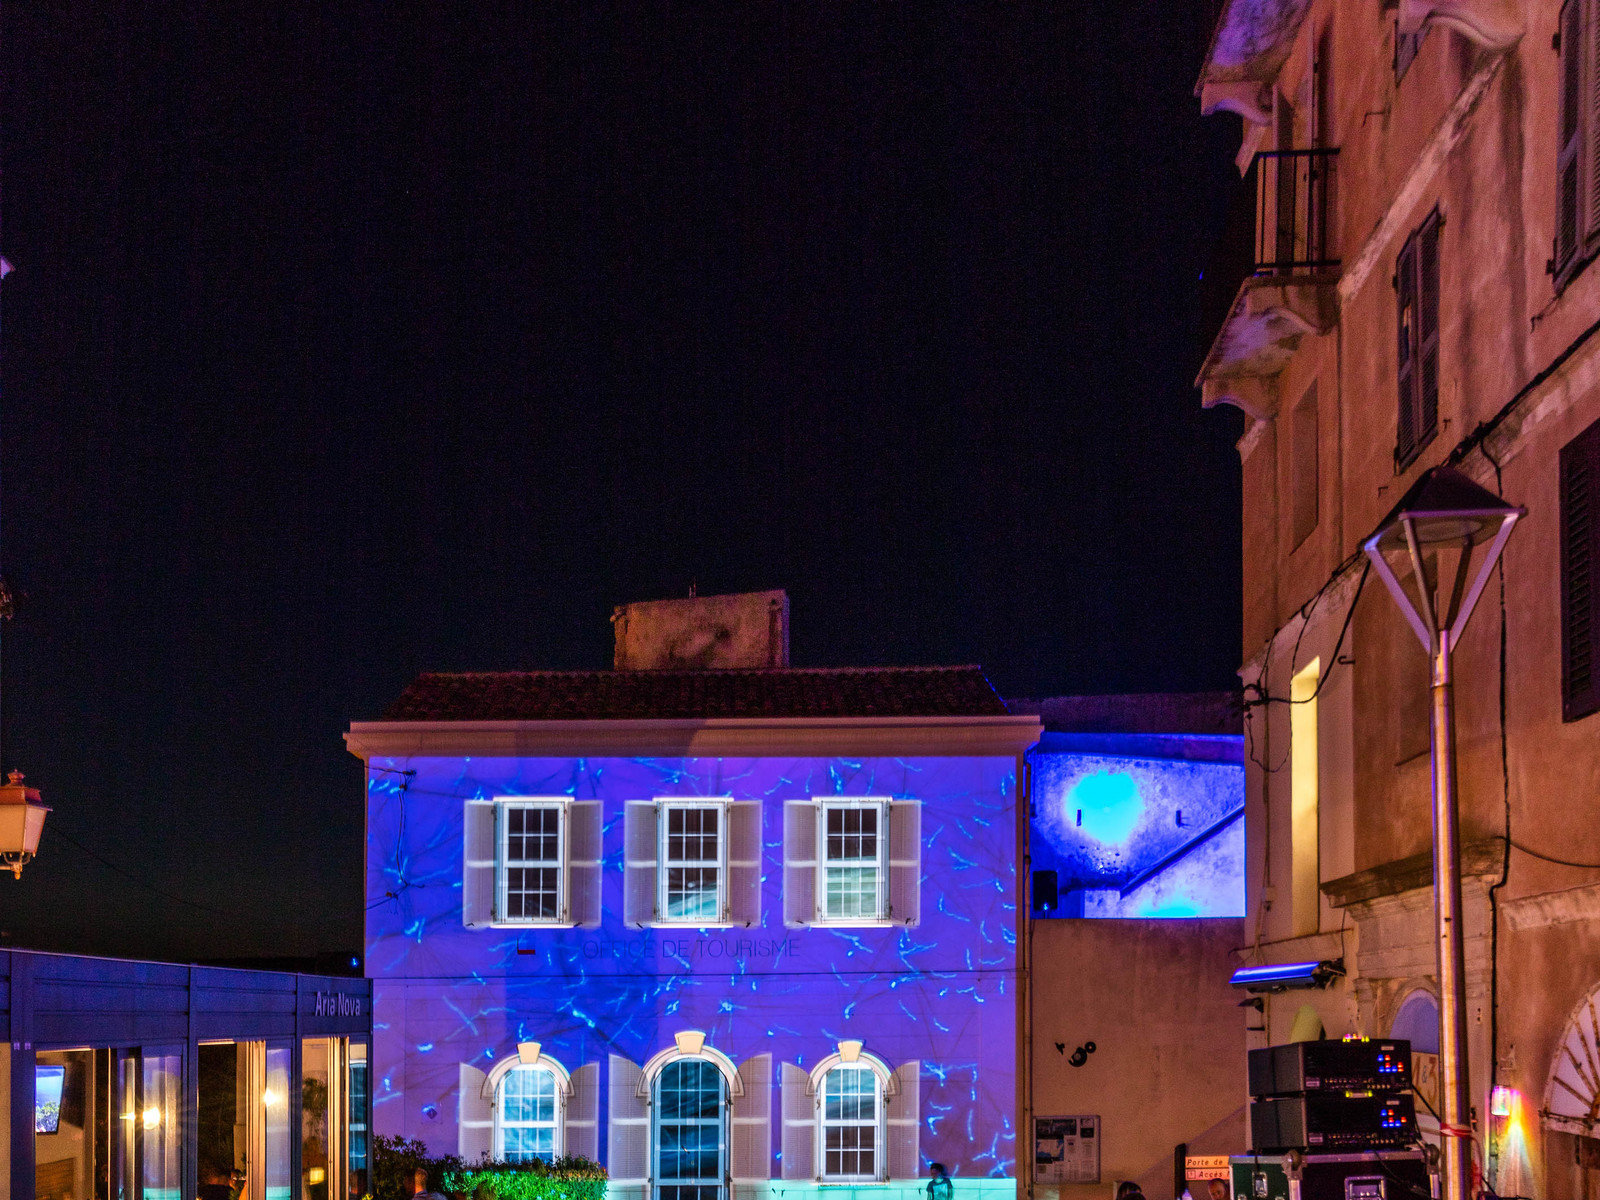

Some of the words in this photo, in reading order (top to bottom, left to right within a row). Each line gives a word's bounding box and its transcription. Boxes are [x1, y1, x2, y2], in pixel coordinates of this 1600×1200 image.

[582, 940, 655, 959] OFFICE
[662, 940, 690, 958] DE
[696, 939, 801, 958] TOURISME
[315, 990, 336, 1017] Aria
[338, 992, 361, 1017] Nova
[1187, 1158, 1209, 1166] Porte
[1213, 1158, 1223, 1166] de
